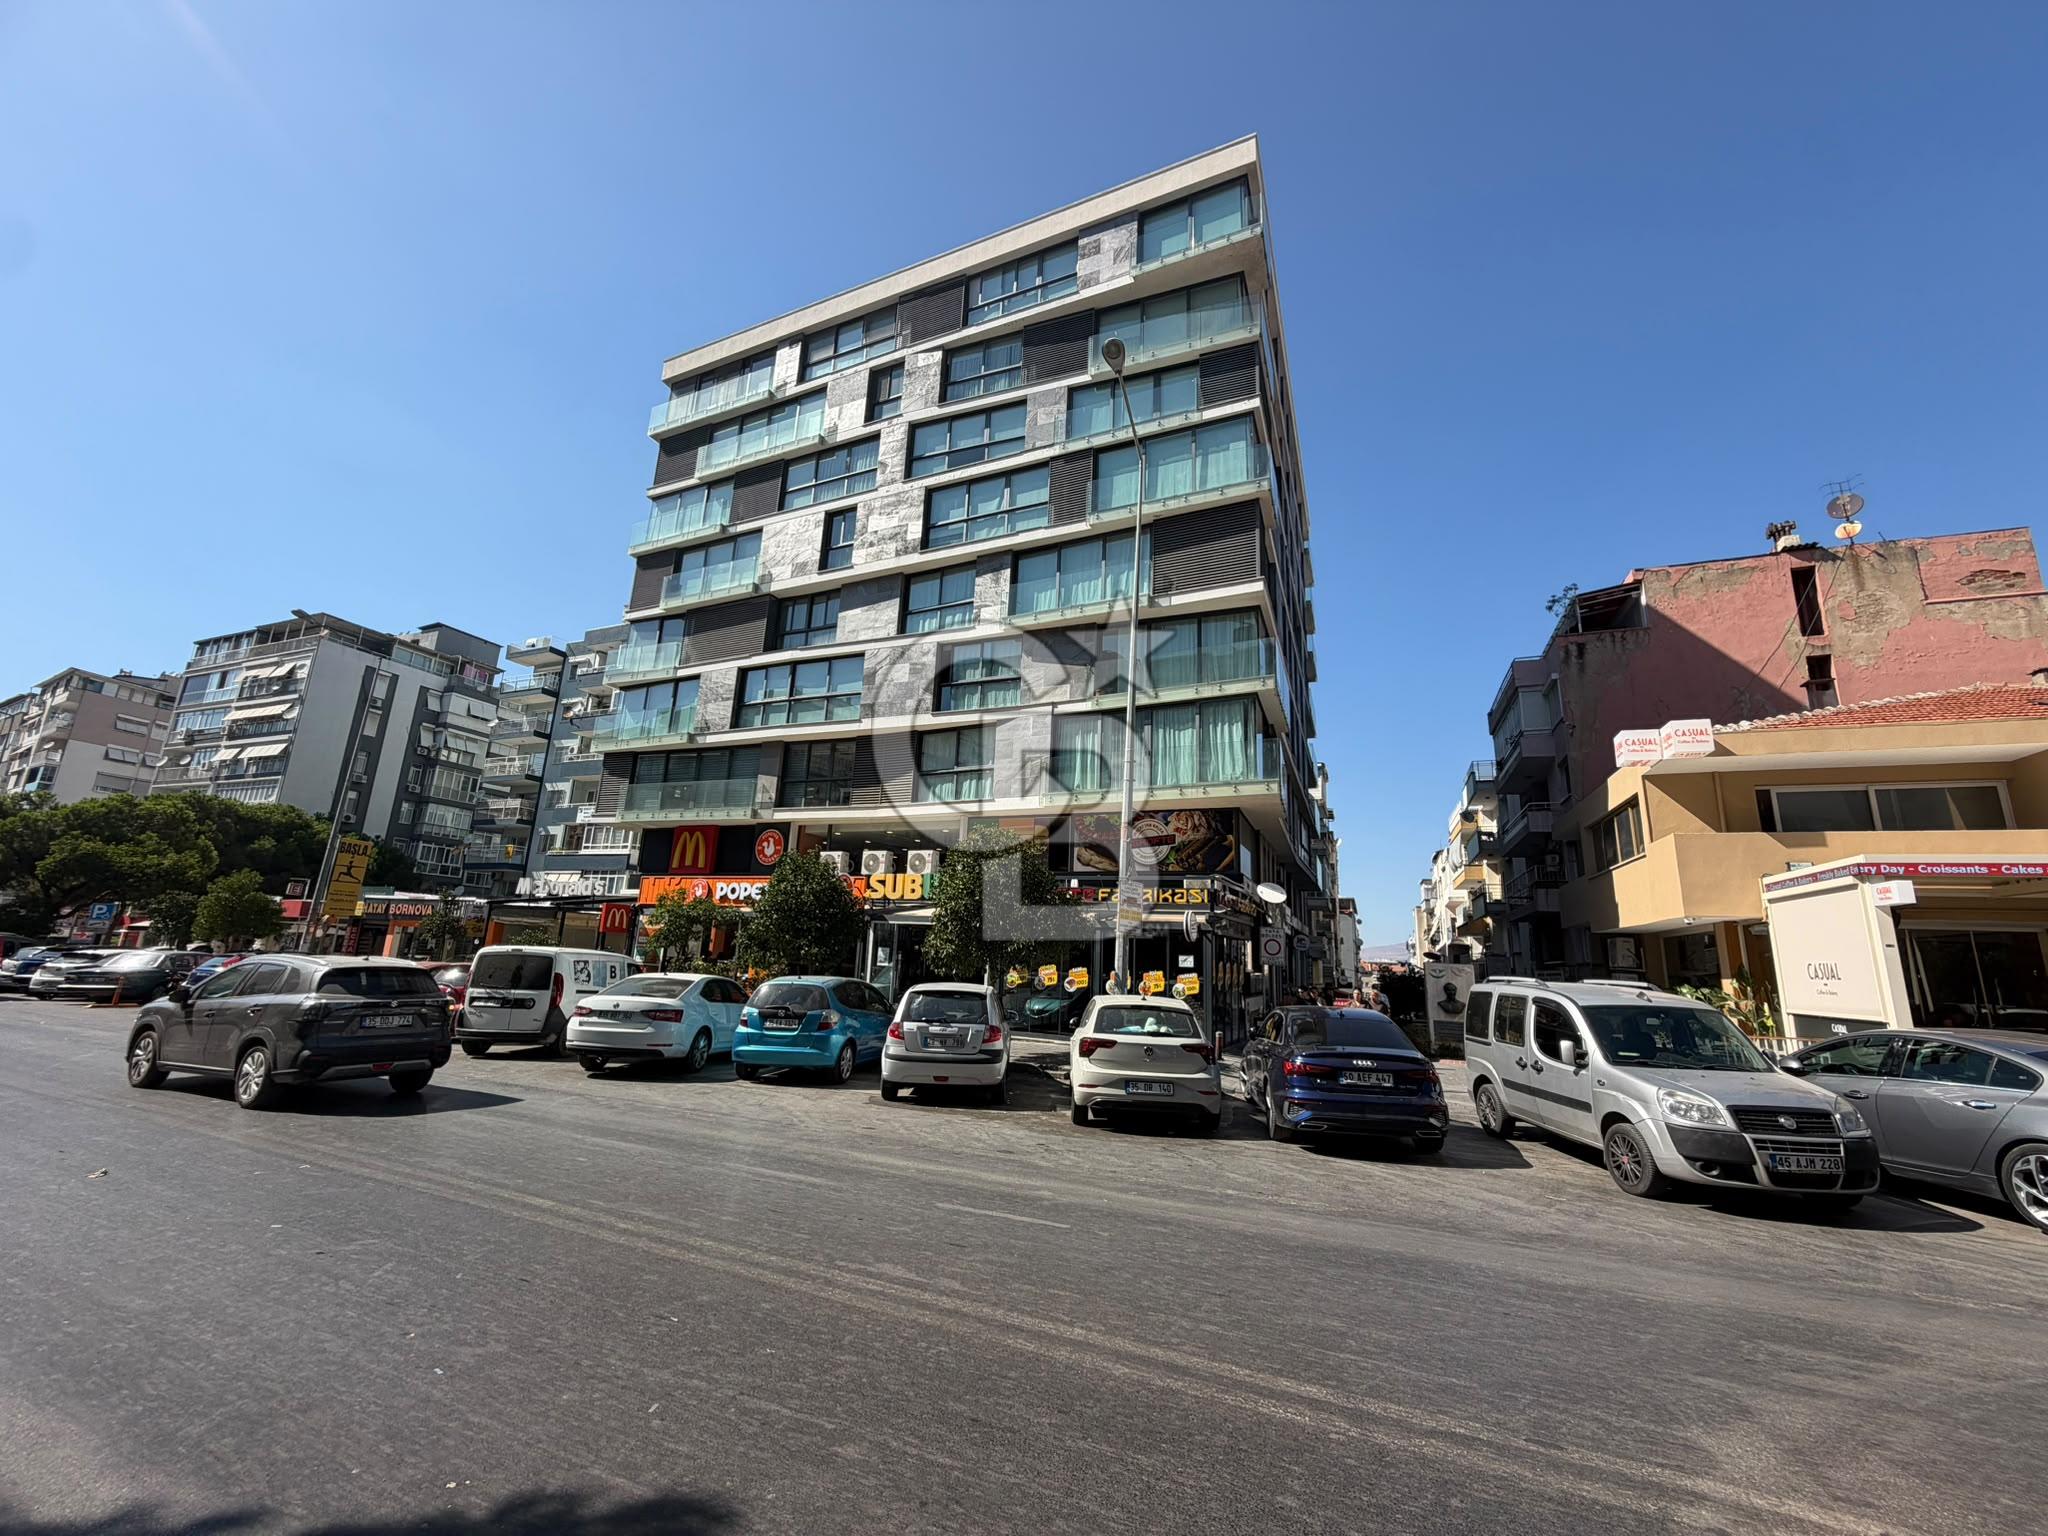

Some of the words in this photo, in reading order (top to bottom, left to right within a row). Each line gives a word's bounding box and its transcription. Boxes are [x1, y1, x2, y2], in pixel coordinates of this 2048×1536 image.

[1674, 728, 1710, 737] CASUAL
[1624, 738, 1658, 746] CASUAL
[340, 842, 368, 857] BAŞLA
[1817, 870, 1834, 882] Freshly
[1834, 867, 1850, 878] Baked
[1880, 865, 1905, 875] Day
[1918, 865, 1988, 874] Croissants
[2001, 865, 2043, 874] Cakes
[515, 877, 606, 897] McDonald's
[92, 905, 104, 919] P
[389, 904, 433, 915] BORNOVA
[609, 965, 617, 979] B
[1807, 962, 1842, 980] CASUAL
[1130, 1082, 1139, 1091] 35
[1777, 1156, 1792, 1169] 45
[1819, 1158, 1841, 1170] 228
